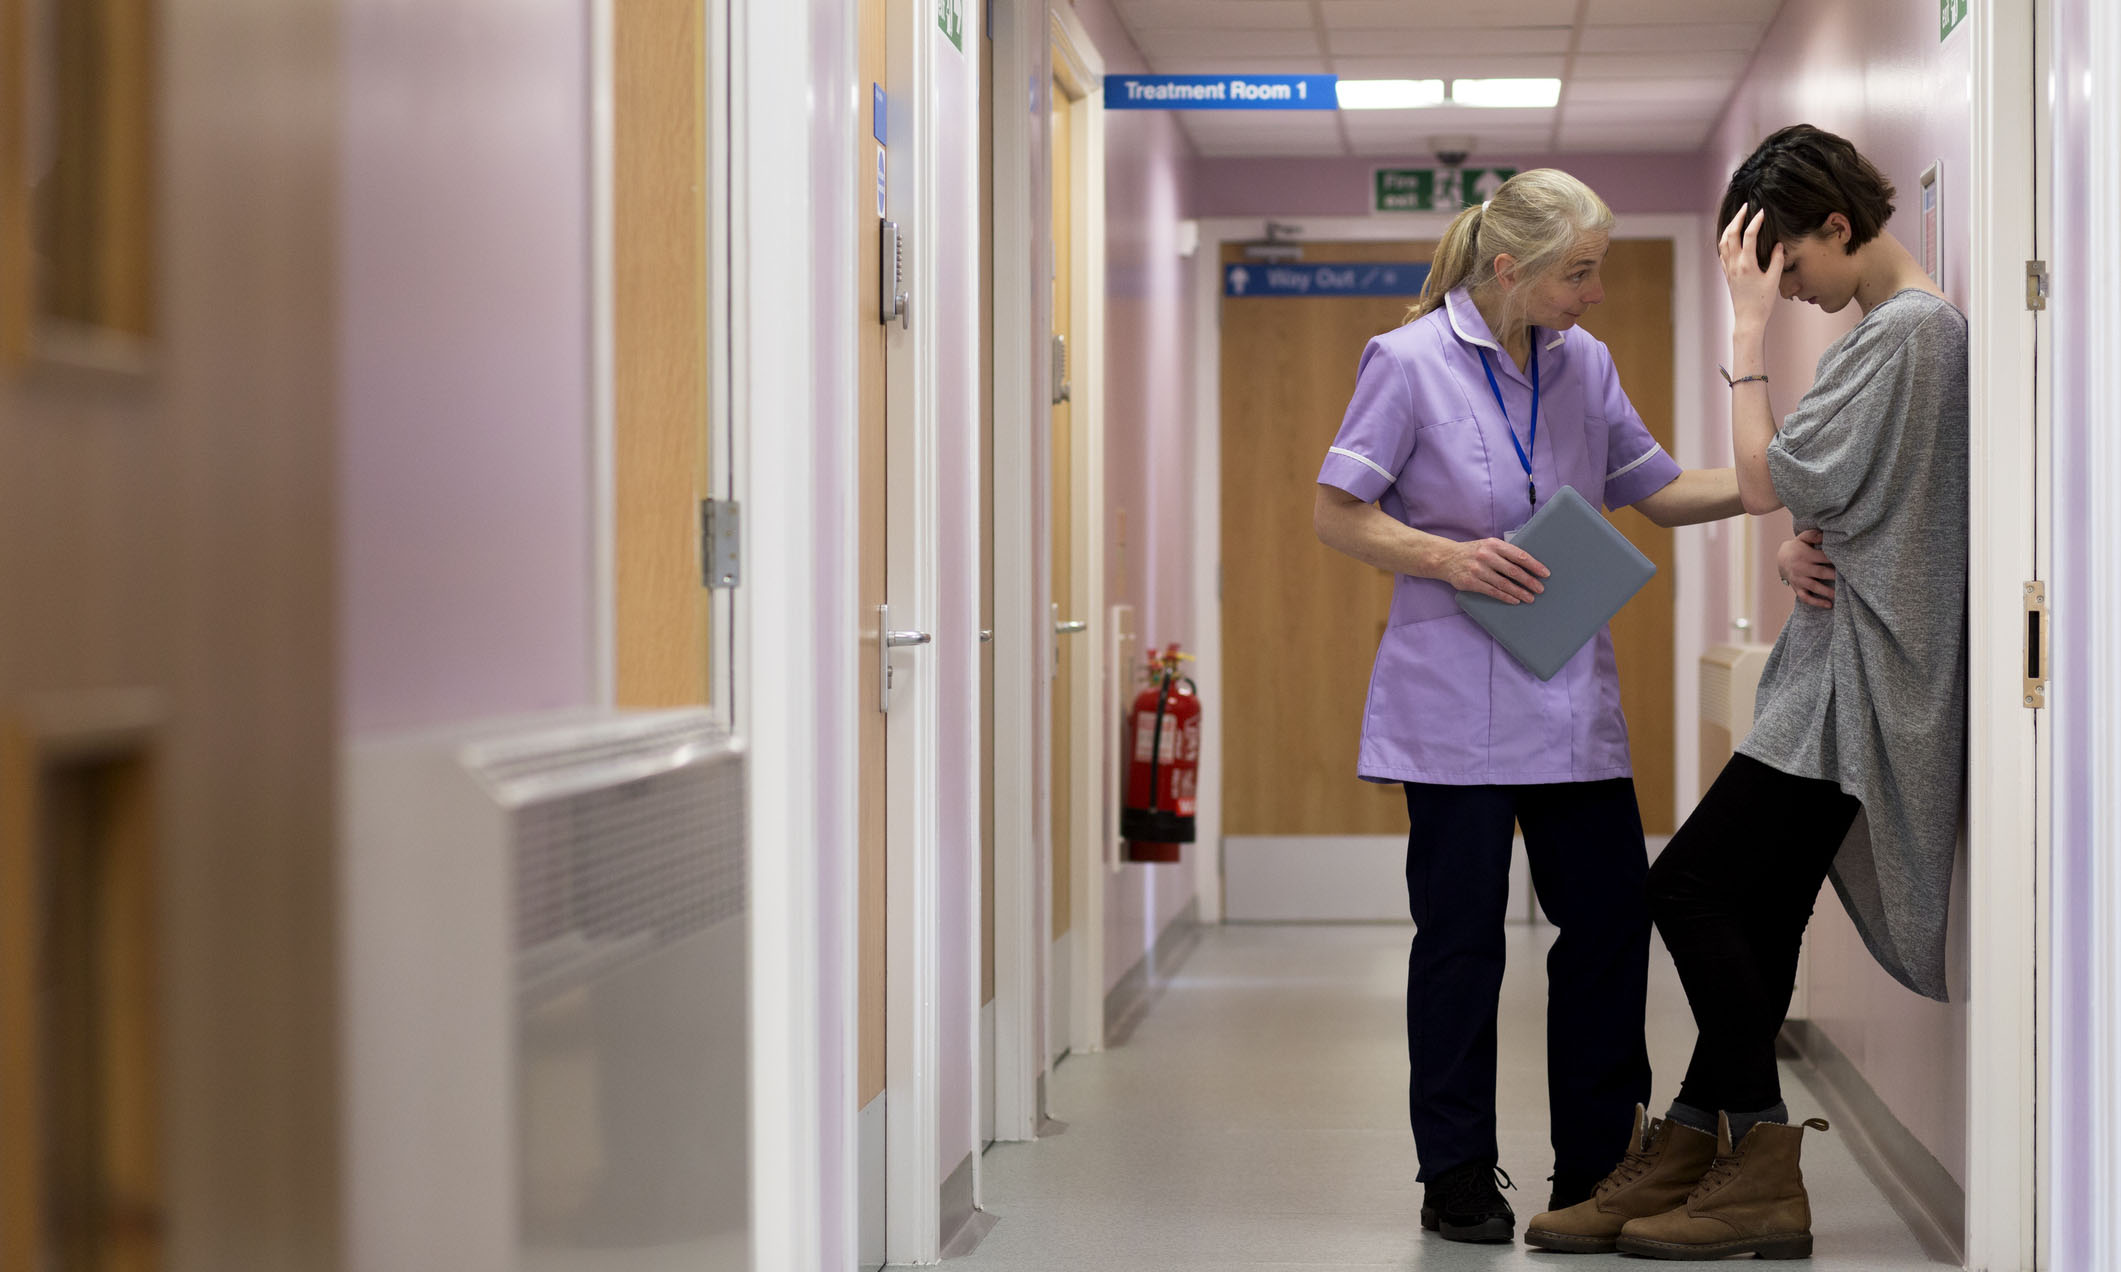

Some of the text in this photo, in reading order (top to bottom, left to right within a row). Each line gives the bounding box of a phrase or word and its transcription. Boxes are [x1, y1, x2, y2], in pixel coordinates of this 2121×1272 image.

[1125, 81, 1307, 100] Treatment Room 1
[1383, 173, 1418, 188] Fire
[1267, 267, 1355, 291] Way Out
